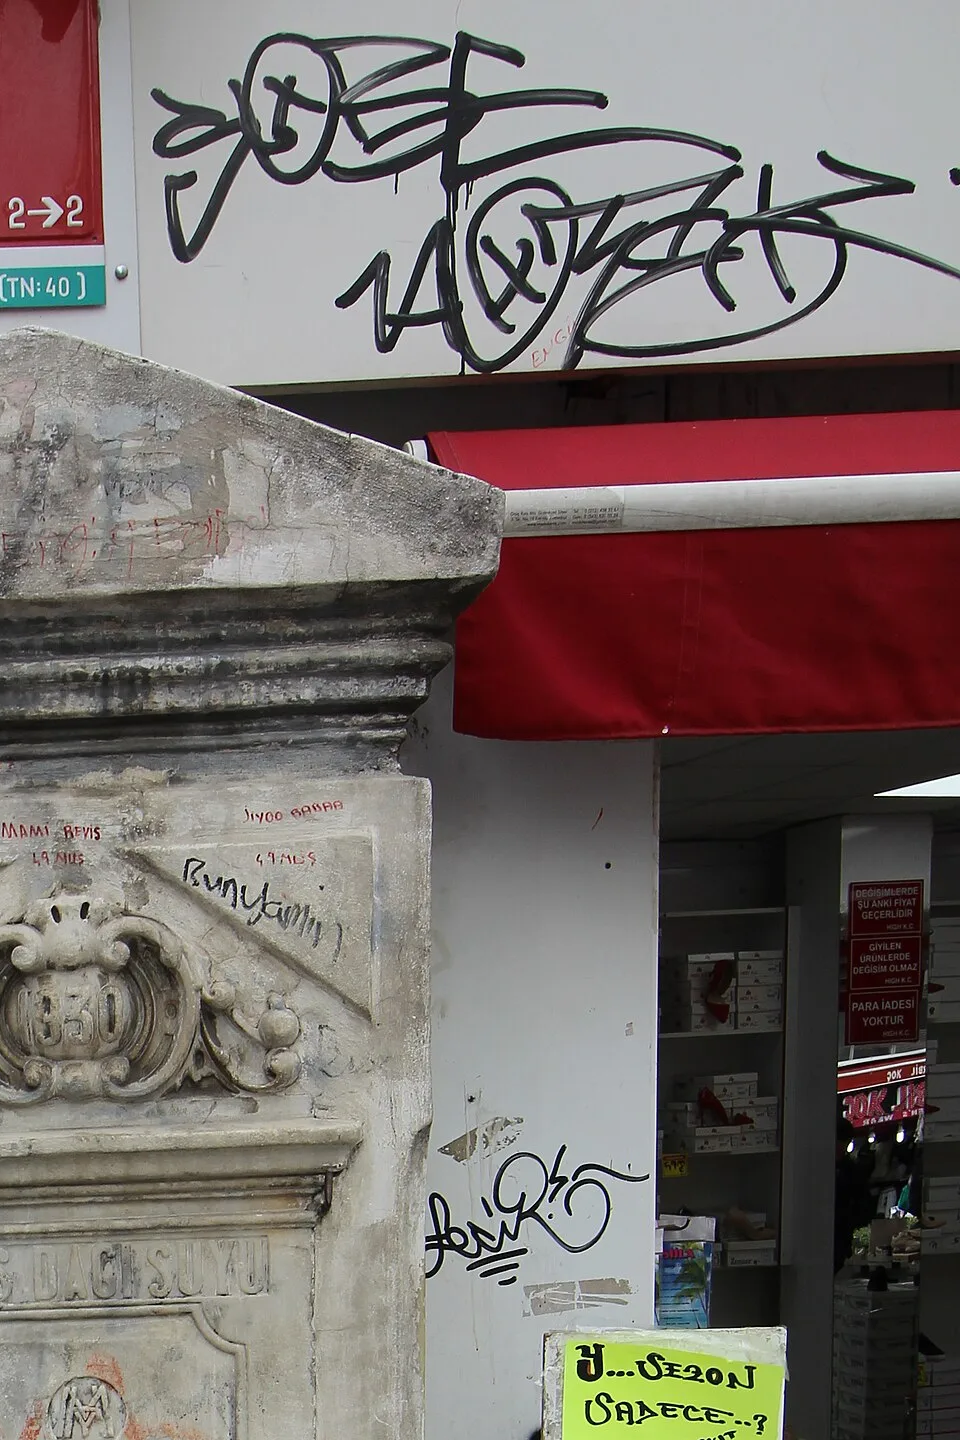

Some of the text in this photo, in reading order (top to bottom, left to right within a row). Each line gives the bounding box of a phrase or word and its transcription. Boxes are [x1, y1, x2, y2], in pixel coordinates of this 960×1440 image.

[8, 195, 83, 230] 2 2
[868, 941, 901, 952] GİYİLEN
[859, 951, 910, 963] ÜRÜNLERDE
[889, 963, 918, 973] OLMAZ
[852, 996, 915, 1013] PARA İADESİ
[862, 1015, 904, 1027] YOKTUR
